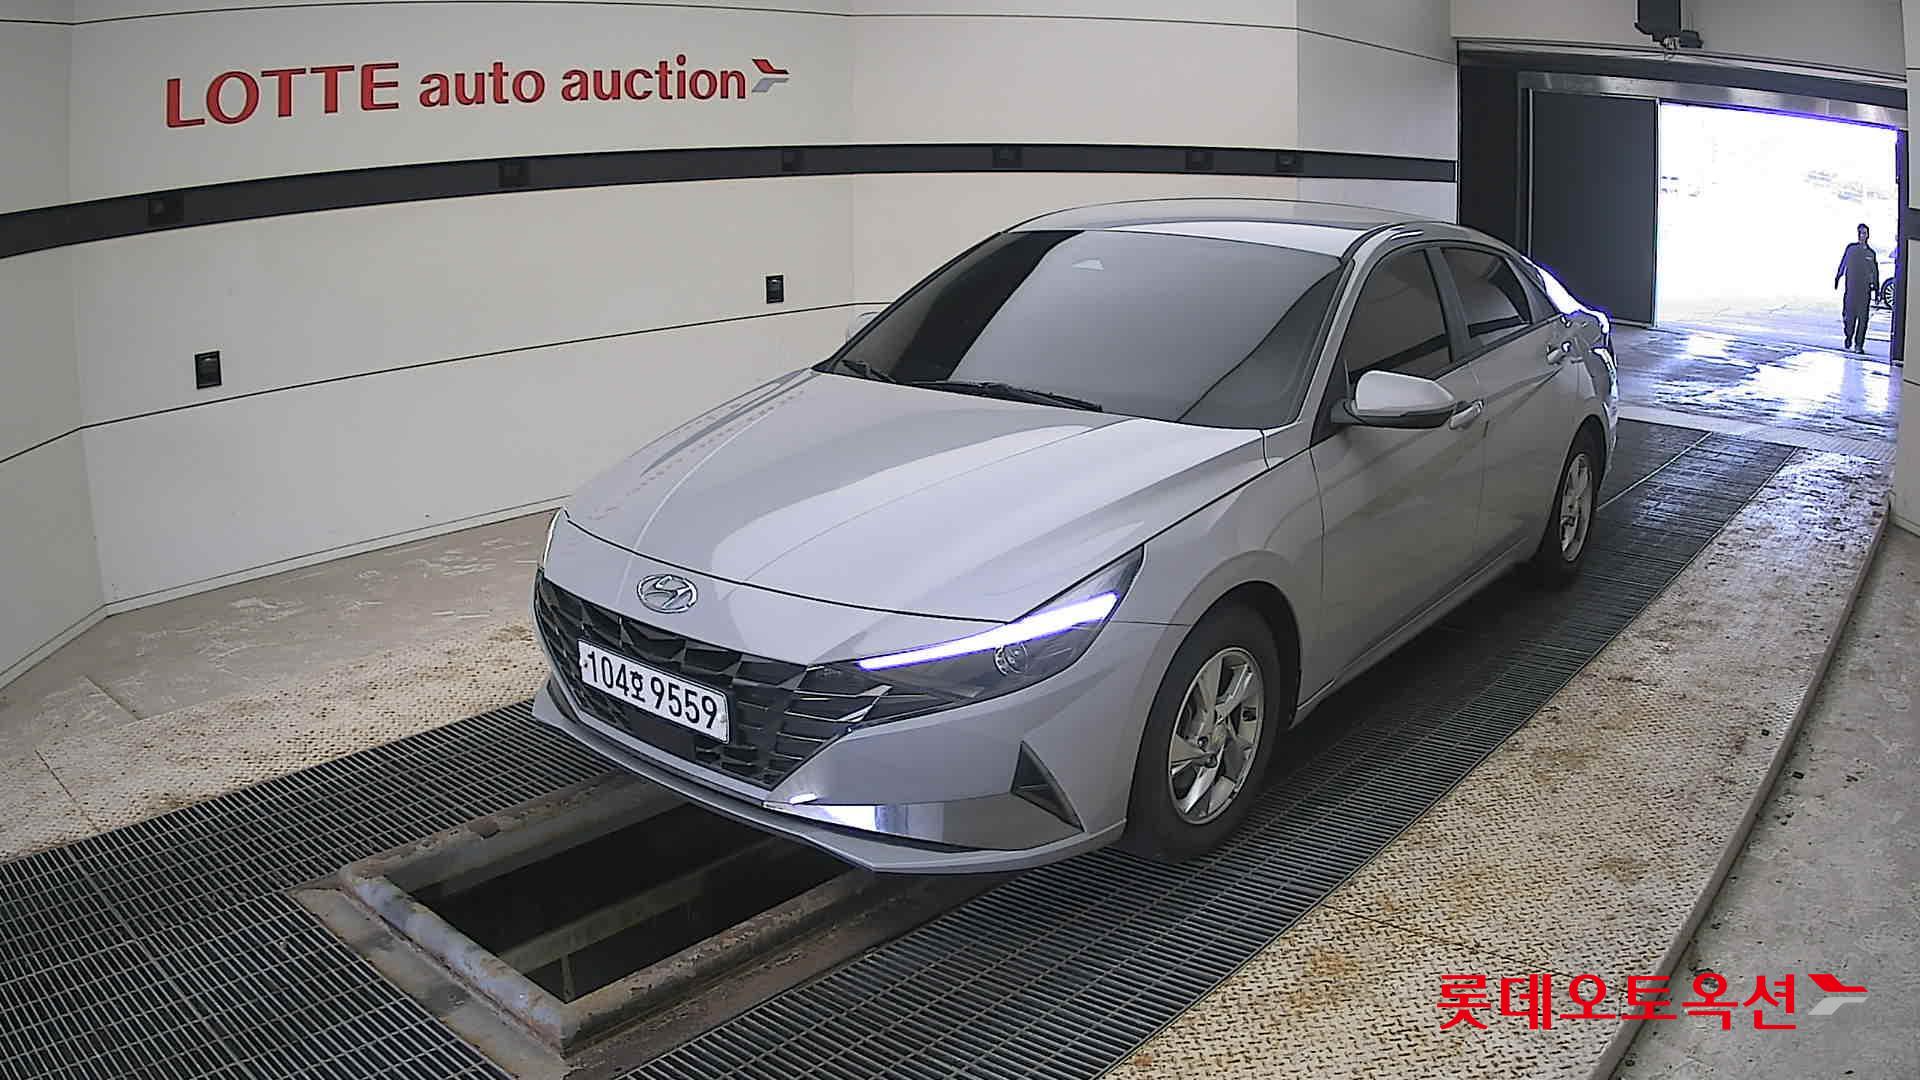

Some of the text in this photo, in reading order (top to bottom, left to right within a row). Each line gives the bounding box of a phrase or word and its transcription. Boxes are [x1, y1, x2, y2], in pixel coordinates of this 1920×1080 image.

[166, 54, 747, 128] LOTTE auto auction
[588, 651, 718, 729] 104호 9559
